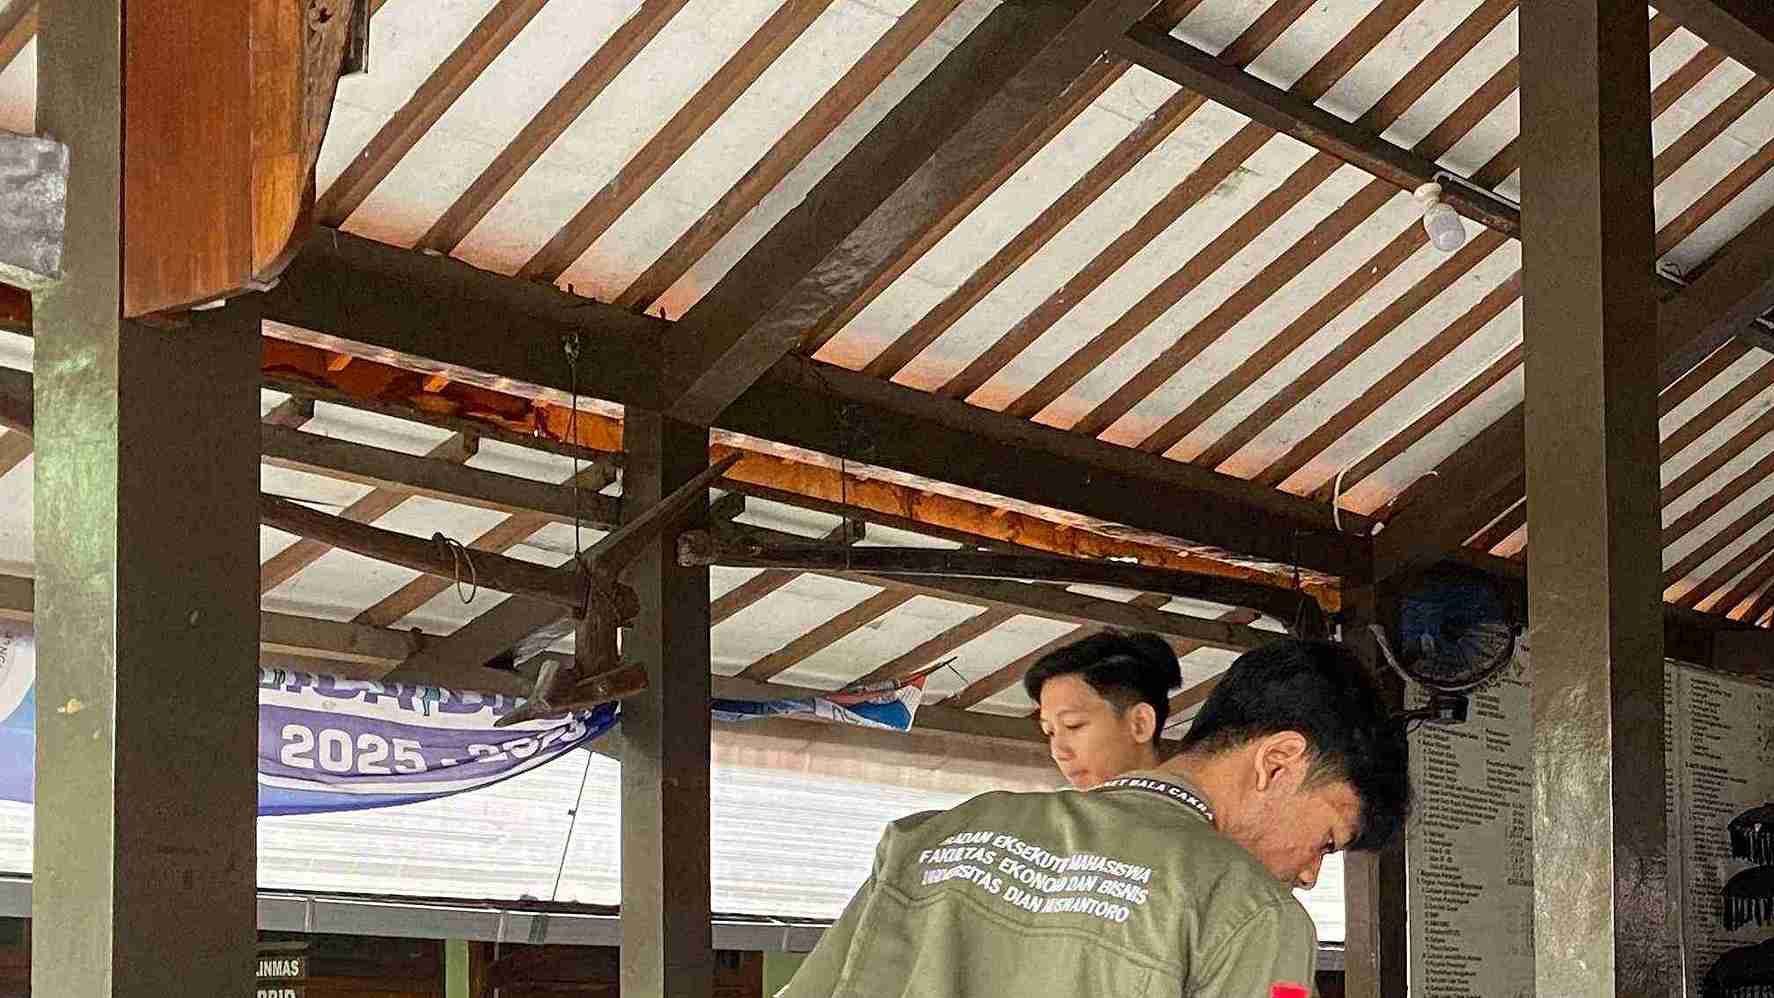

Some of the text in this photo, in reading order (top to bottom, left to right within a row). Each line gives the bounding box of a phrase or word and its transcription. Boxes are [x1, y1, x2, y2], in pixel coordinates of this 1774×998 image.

[280, 723, 428, 775] 2025
[1003, 886, 1044, 913] DIAN
[256, 960, 300, 977] INMAS
